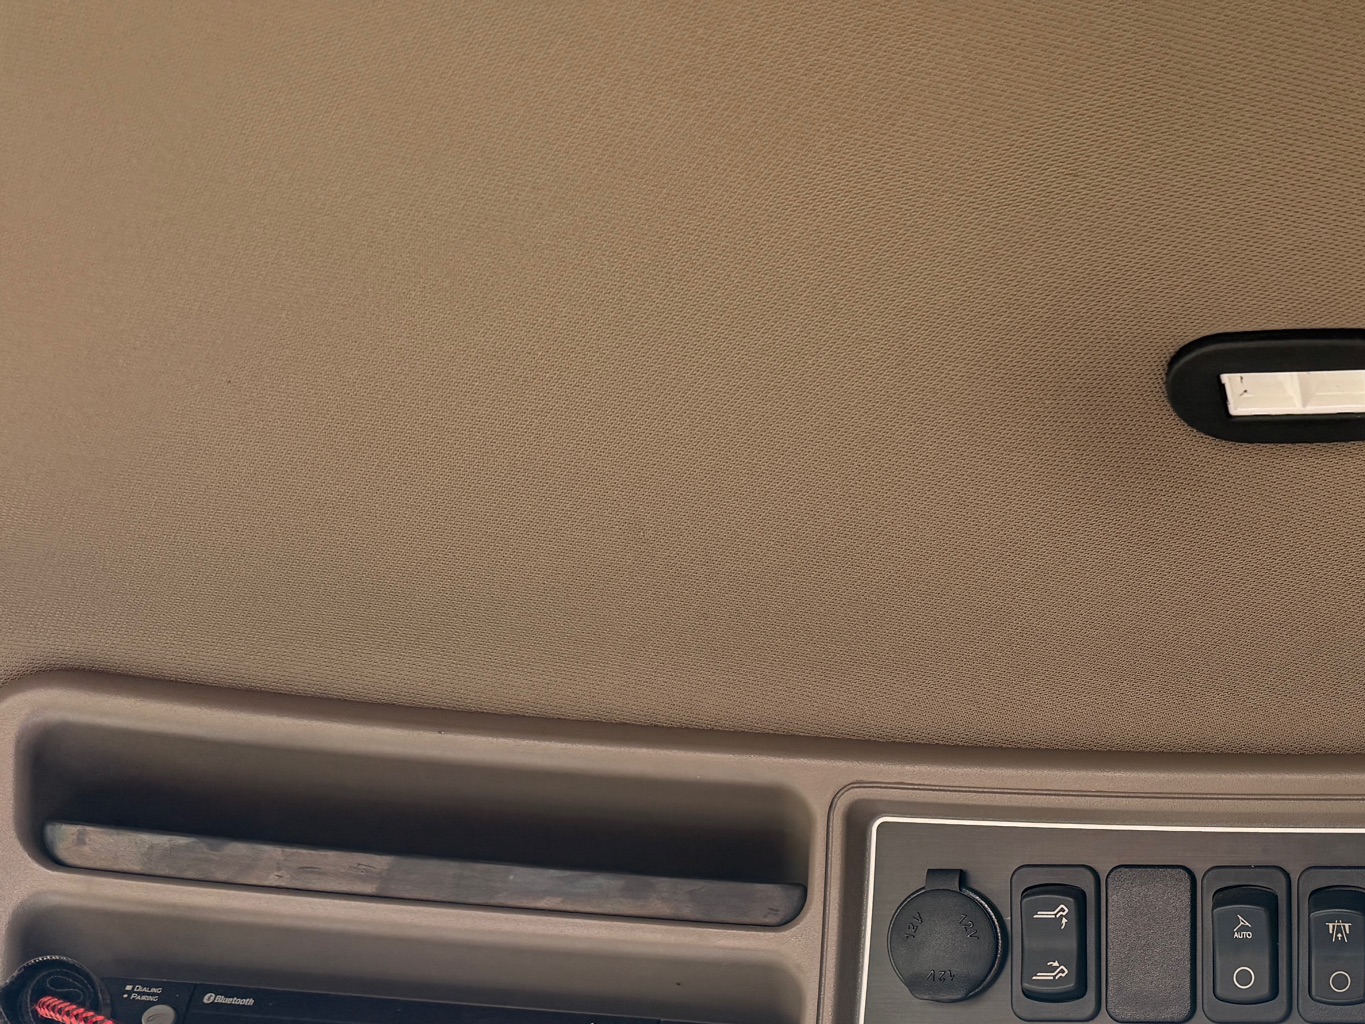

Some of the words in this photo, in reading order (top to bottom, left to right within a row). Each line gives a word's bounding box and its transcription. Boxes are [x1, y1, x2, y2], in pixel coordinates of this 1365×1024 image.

[1233, 931, 1253, 939] AUTO
[134, 984, 162, 994] DIALING
[130, 993, 159, 1002] PAIRING
[213, 994, 255, 1006] Bluetooth
